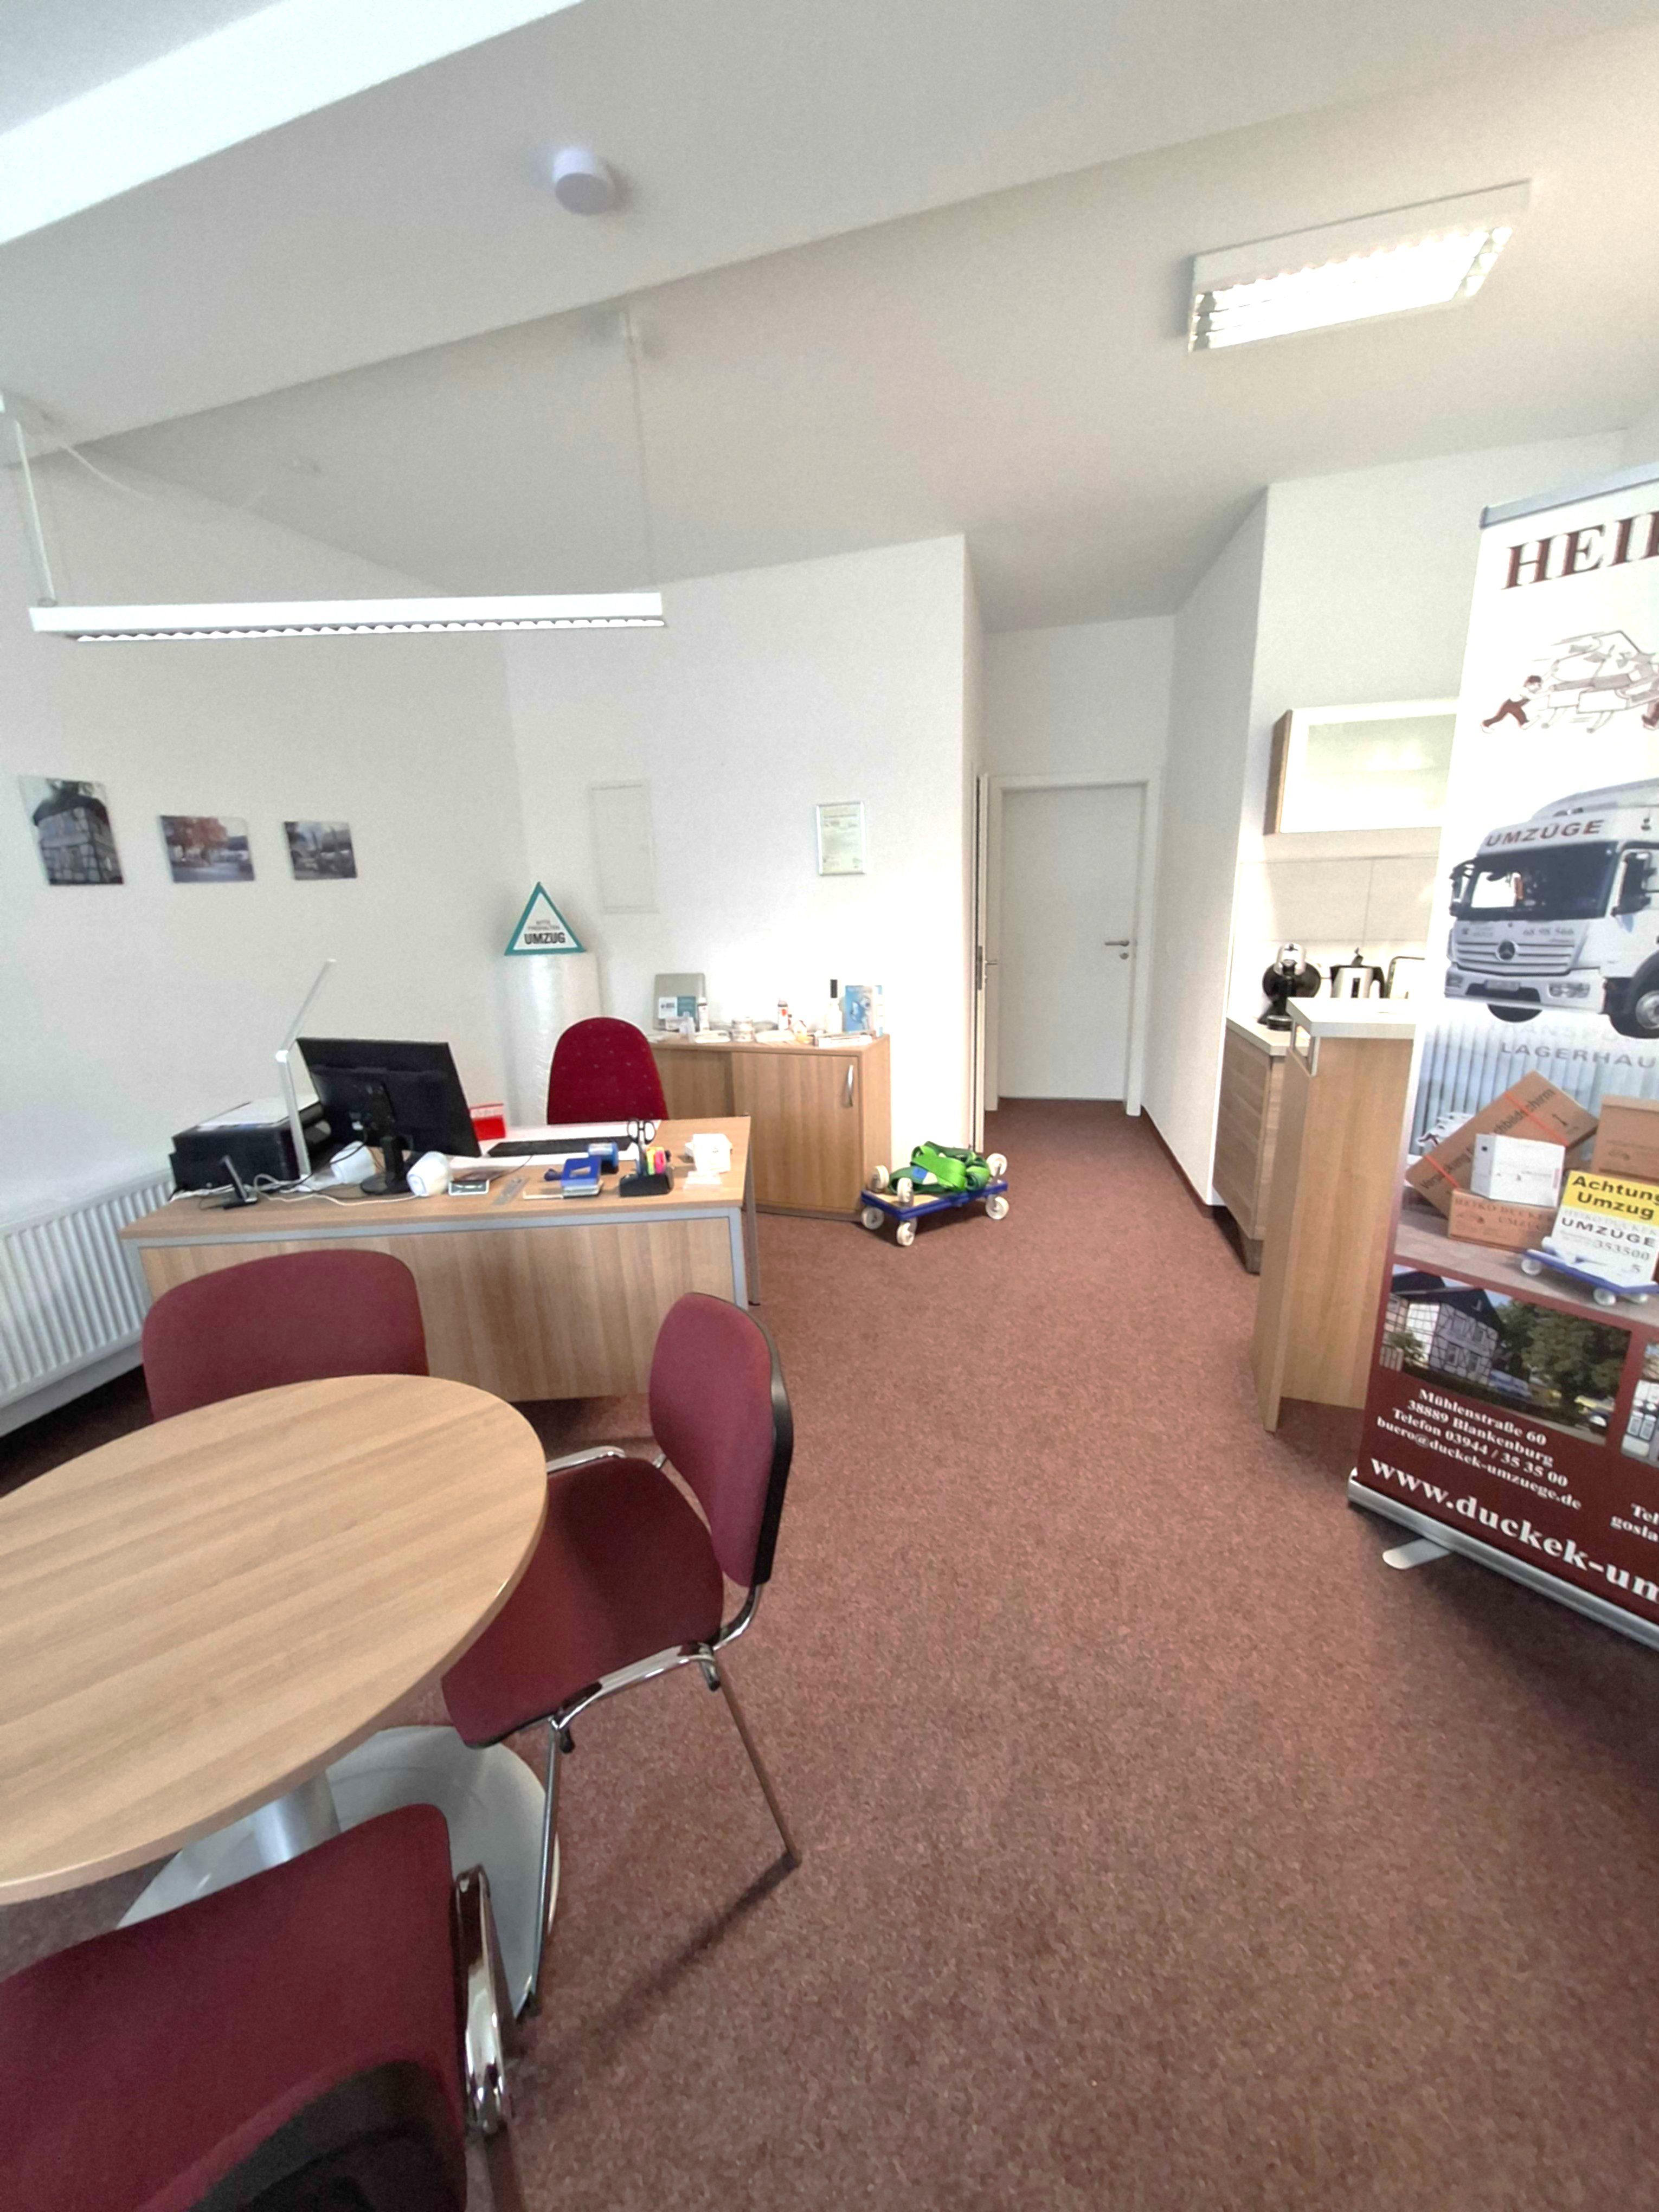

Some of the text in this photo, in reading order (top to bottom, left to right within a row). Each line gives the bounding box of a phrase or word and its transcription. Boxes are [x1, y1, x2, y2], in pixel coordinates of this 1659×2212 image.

[524, 932, 565, 944] UMZUG
[1577, 1191, 1654, 1221] Umzug
[1392, 1407, 1442, 1437] Telefon
[1445, 1430, 1488, 1456] 03944
[1500, 1452, 1520, 1468] 35
[1523, 1461, 1544, 1477] 35
[1547, 1471, 1568, 1487] 00
[1407, 1399, 1554, 1468] 38889 Blankenburg
[1418, 1388, 1547, 1446] Mühlenstraße 60
[1377, 1416, 1582, 1510] buero@duckek-umzuege.de
